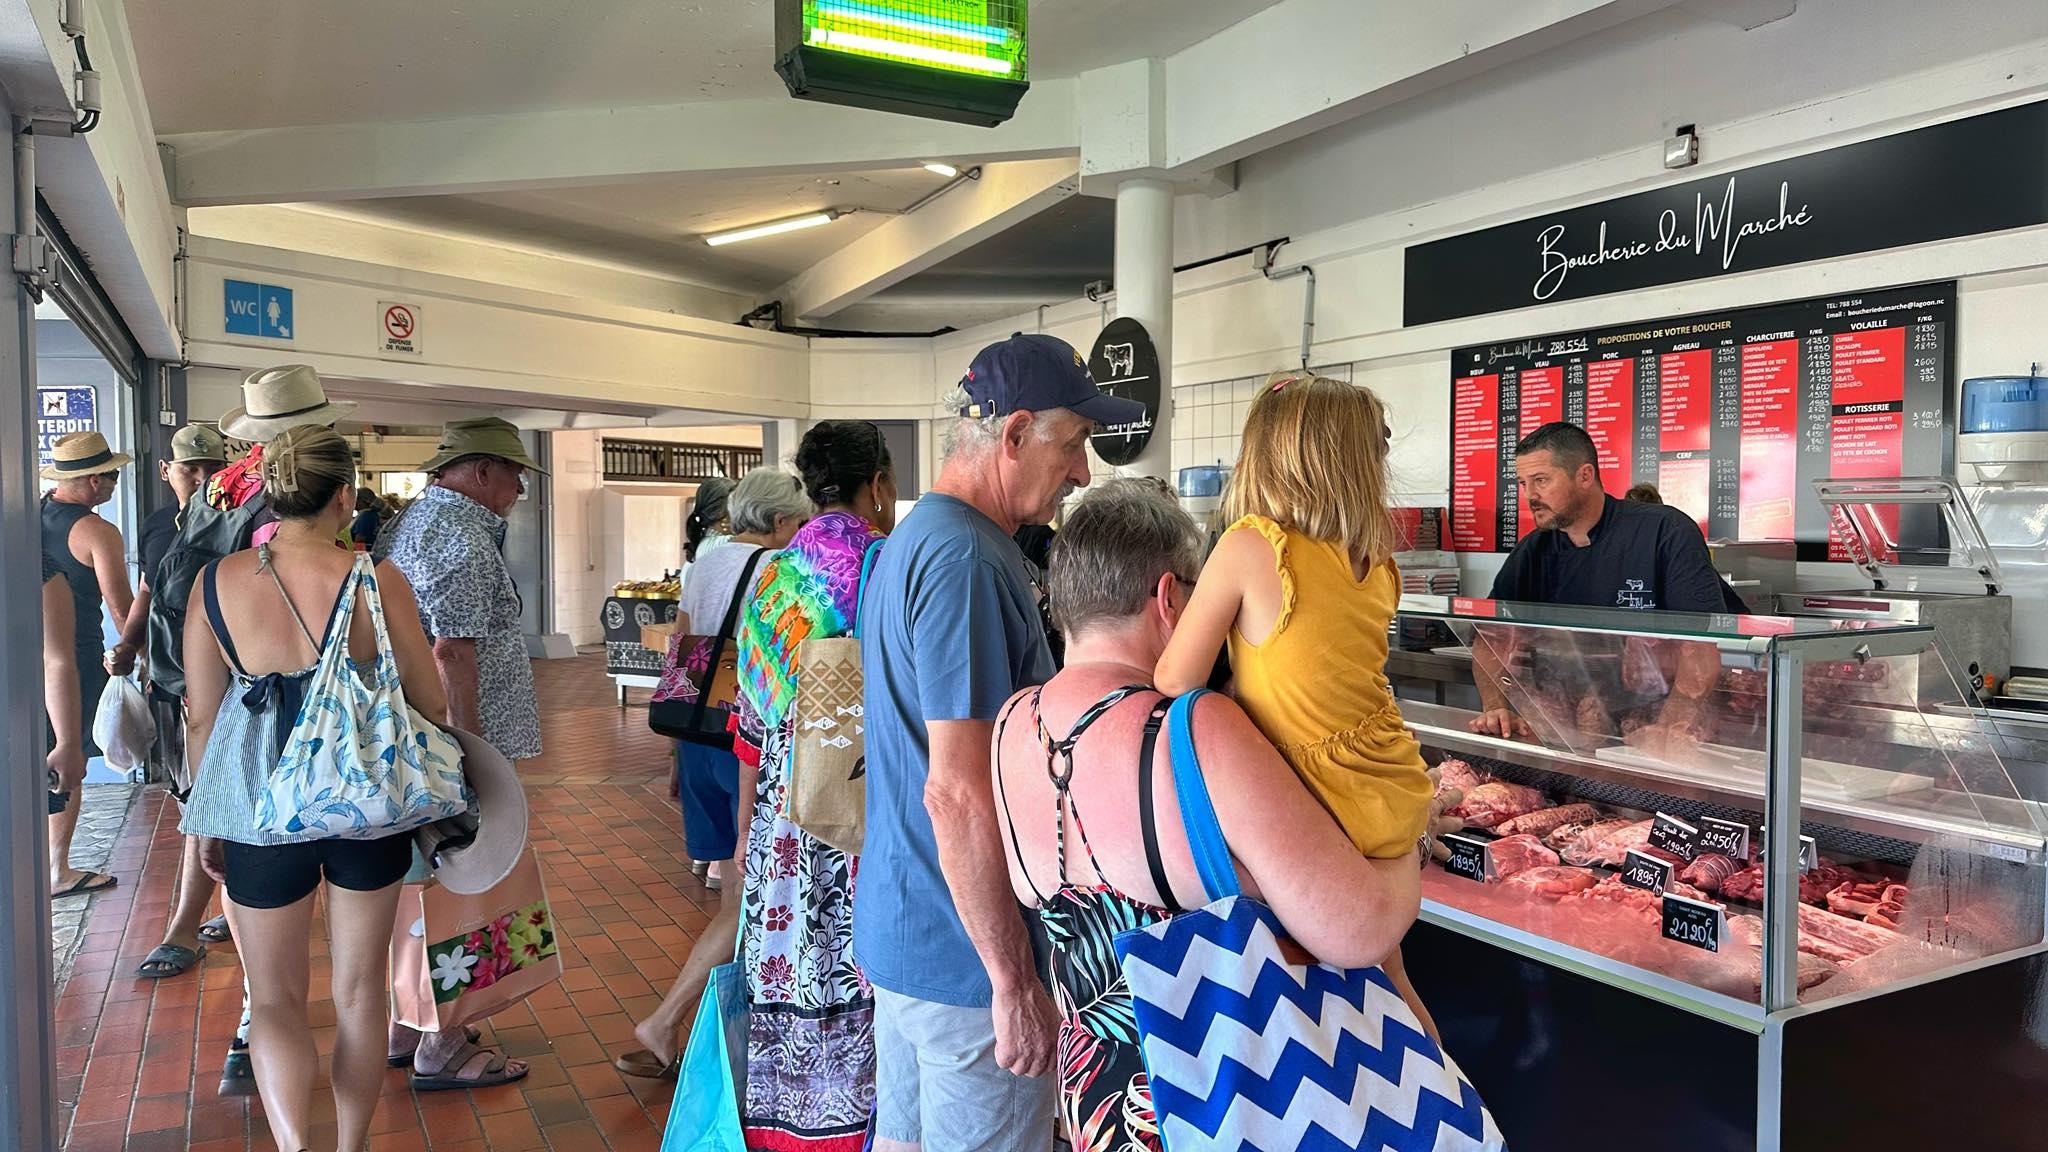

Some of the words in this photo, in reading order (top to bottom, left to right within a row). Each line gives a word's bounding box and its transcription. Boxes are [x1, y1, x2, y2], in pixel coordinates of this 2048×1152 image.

[1533, 221, 1651, 300] Boucherie
[1655, 209, 1691, 252] du
[1696, 177, 1813, 270] Marché
[231, 299, 256, 316] WC
[1826, 310, 1842, 318] Email
[1848, 299, 1945, 316] boucheriedumarche@lagoon.nc
[1850, 320, 1887, 331] VOLAILLE
[1597, 331, 1651, 345] PROPOSITIONS
[1653, 330, 1663, 338] DE
[1665, 326, 1690, 337] VOTRE
[1693, 321, 1732, 333] BOUCHER
[1746, 331, 1795, 342] CHARCUTERIE
[1673, 342, 1700, 351] AGNEAU
[1845, 404, 1890, 413] ROTISSERIE
[38, 420, 92, 433] TERDIT
